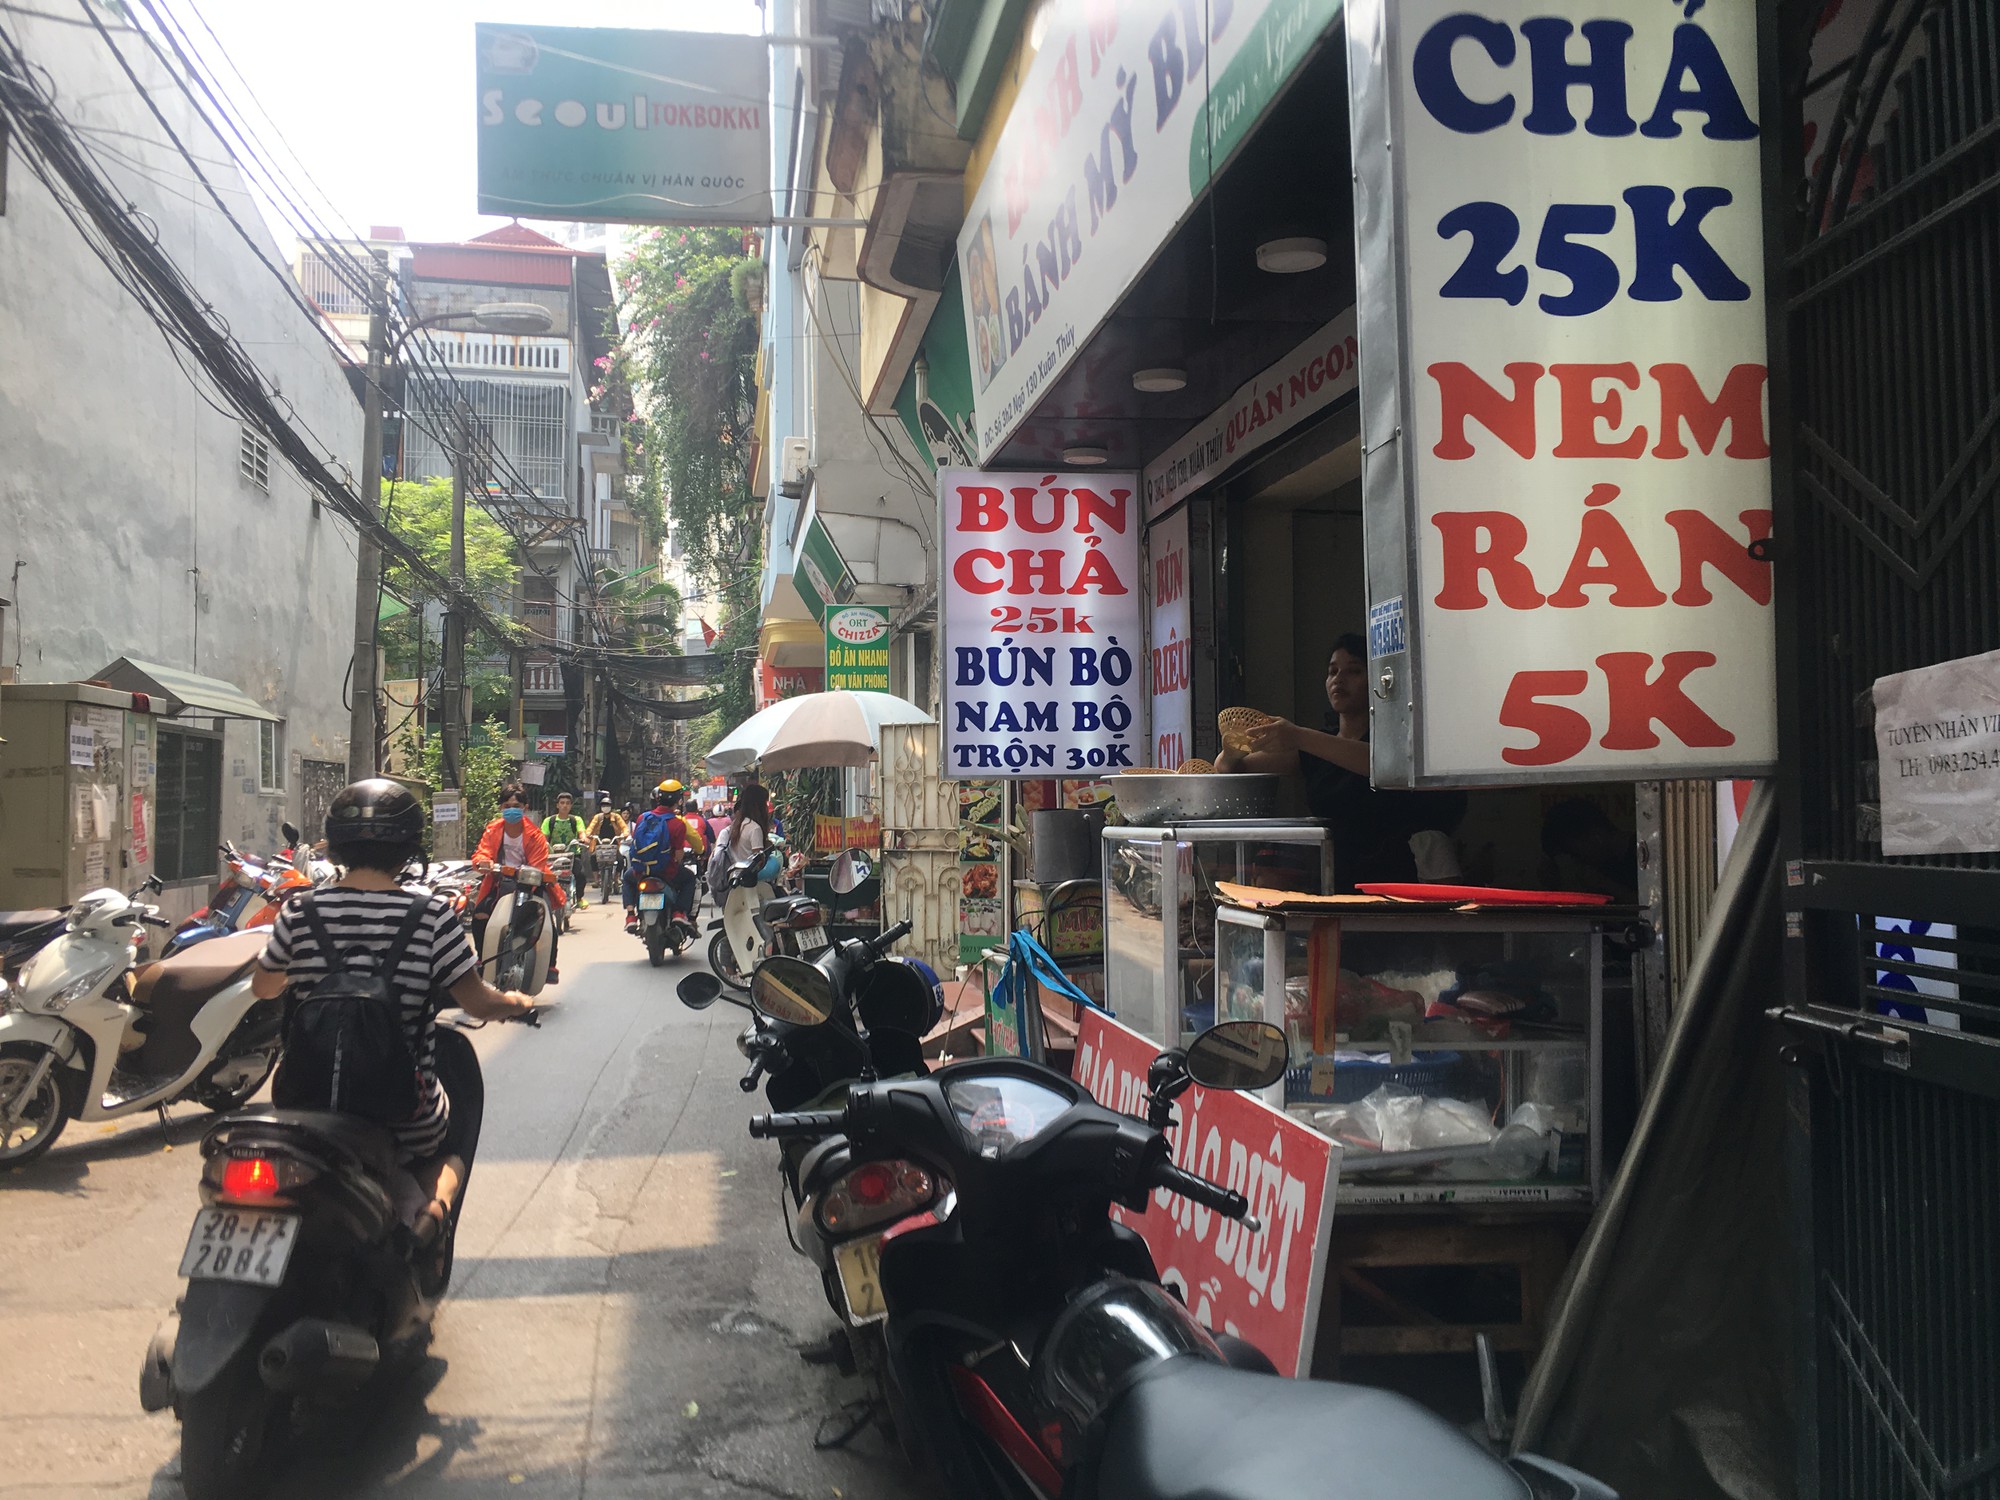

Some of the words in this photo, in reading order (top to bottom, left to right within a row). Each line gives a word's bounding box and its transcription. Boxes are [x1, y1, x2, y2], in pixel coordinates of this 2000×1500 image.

[482, 90, 648, 131] Seoul
[652, 102, 761, 130] TOKBOKKI
[641, 173, 657, 188] VỊ
[1005, 185, 1082, 357] BÁNH
[1437, 185, 1751, 317] 25K
[1025, 371, 1038, 398] 130
[1037, 351, 1057, 383] Xuân
[1226, 382, 1284, 453] QUÁN
[1427, 361, 1771, 460] NEM
[956, 475, 1132, 534] BÚN
[953, 535, 1129, 595] CHẢ
[1431, 482, 1773, 610] RÁN
[1156, 539, 1184, 608] BÚN
[838, 626, 880, 641] CHIZZA
[990, 606, 1095, 633] 25k
[844, 646, 856, 667] ĂN
[858, 650, 888, 667] NHANH
[848, 671, 862, 689] VĂN
[955, 637, 1056, 686] BÚN
[1069, 636, 1132, 686] BÒ
[1152, 627, 1191, 696] RIÊU
[955, 701, 1058, 732] NAM
[1071, 694, 1132, 739] BỘ
[1499, 651, 1736, 766] 5K
[537, 740, 564, 751] XE
[953, 738, 1056, 773] TRỘN
[1066, 743, 1133, 770] 30K
[1158, 732, 1185, 770] CUA
[1215, 1132, 1307, 1312] BIỆT
